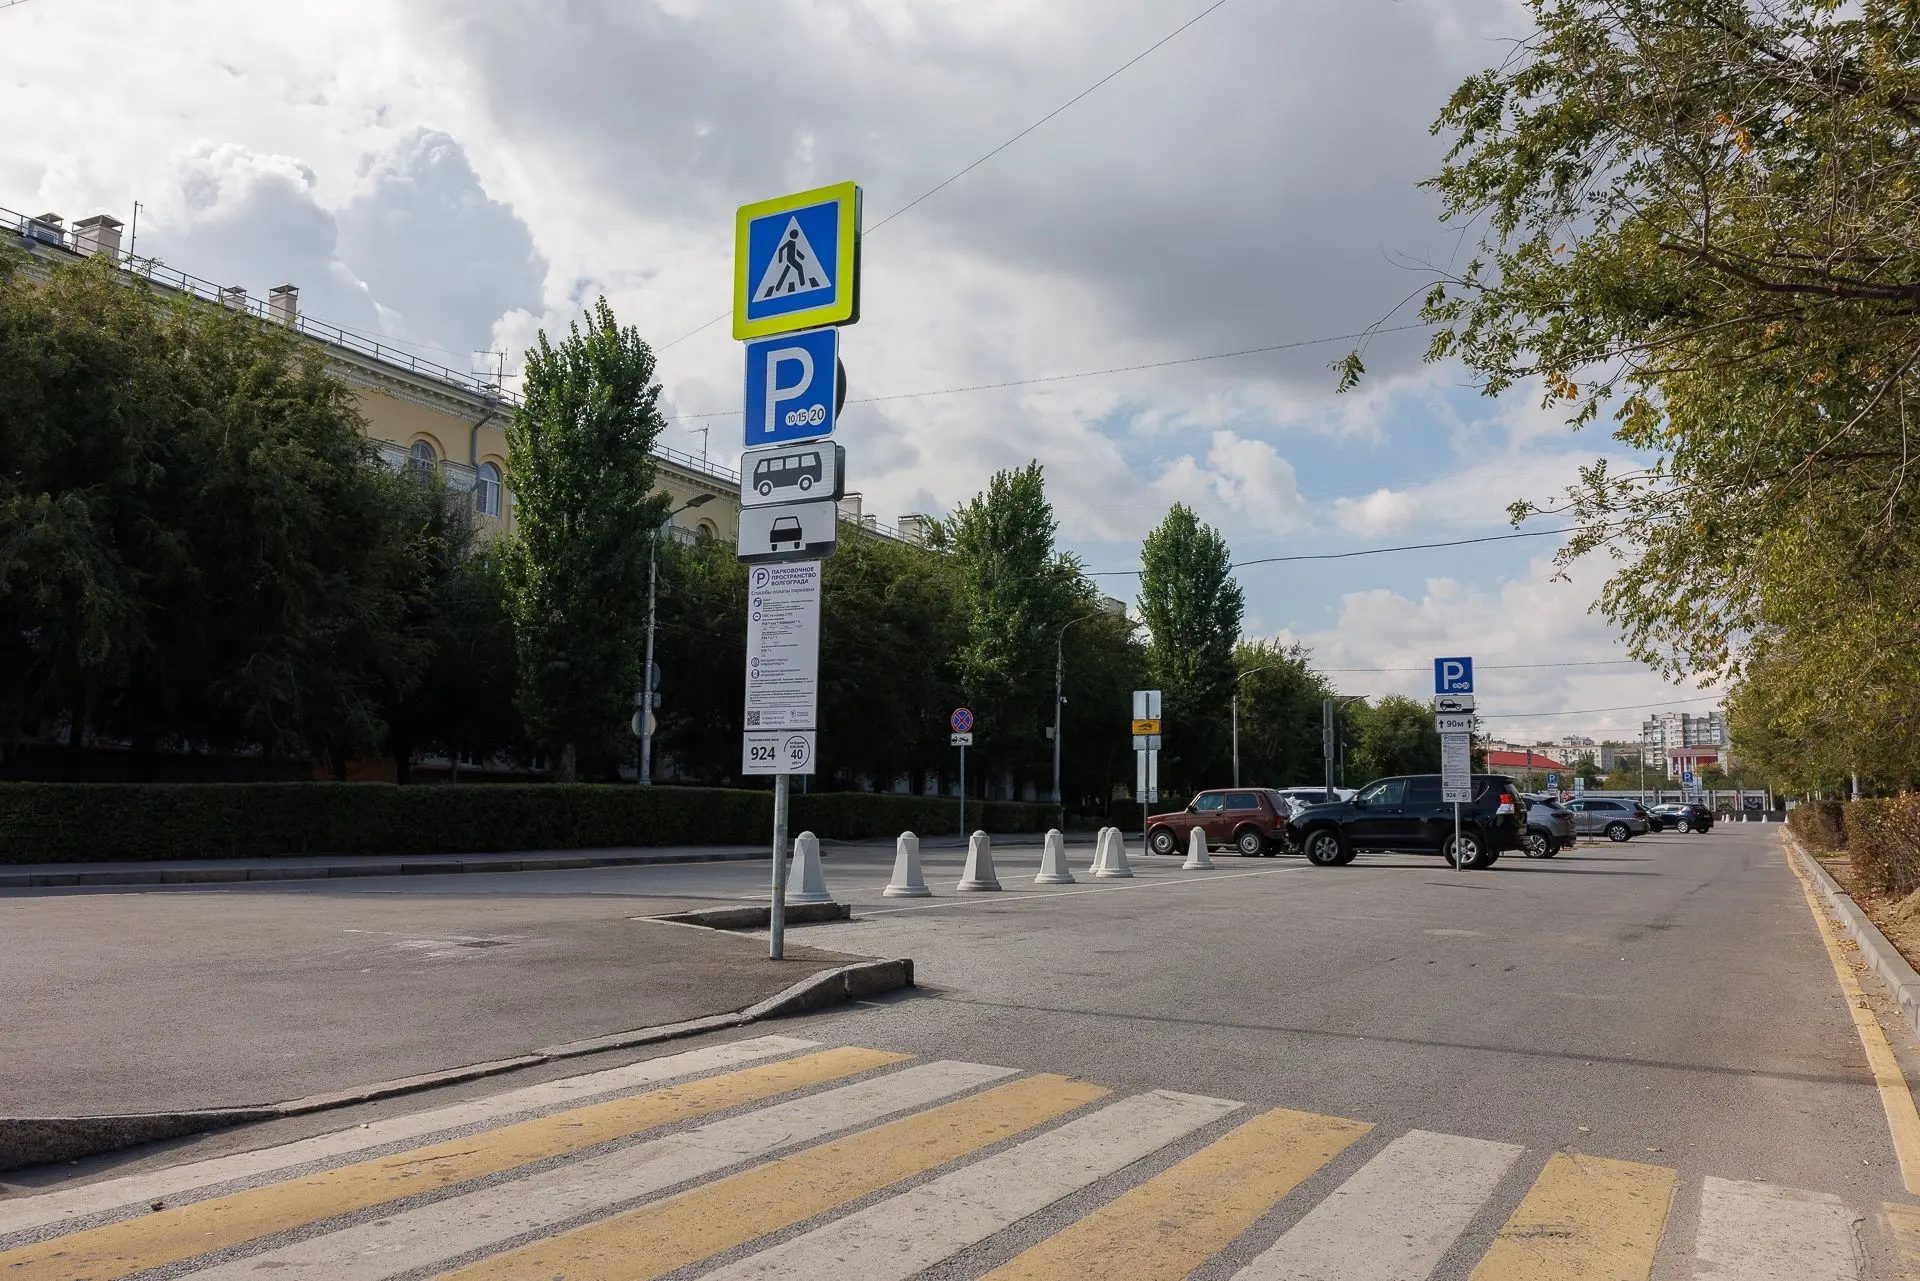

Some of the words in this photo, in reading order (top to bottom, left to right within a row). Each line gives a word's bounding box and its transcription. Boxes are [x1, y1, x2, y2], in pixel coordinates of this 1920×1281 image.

[765, 347, 814, 432] P
[788, 414, 796, 424] 10
[797, 411, 807, 422] 15
[810, 408, 825, 421] 20
[771, 566, 815, 574] ПАРКОВОЧНОЕ
[771, 572, 817, 580] ПРОСТРАНСТВО
[757, 572, 766, 585] P
[1443, 661, 1464, 690] P
[750, 746, 776, 760] 924
[790, 749, 803, 760] 40
[1549, 774, 1556, 783] P
[1684, 773, 1691, 781] P
